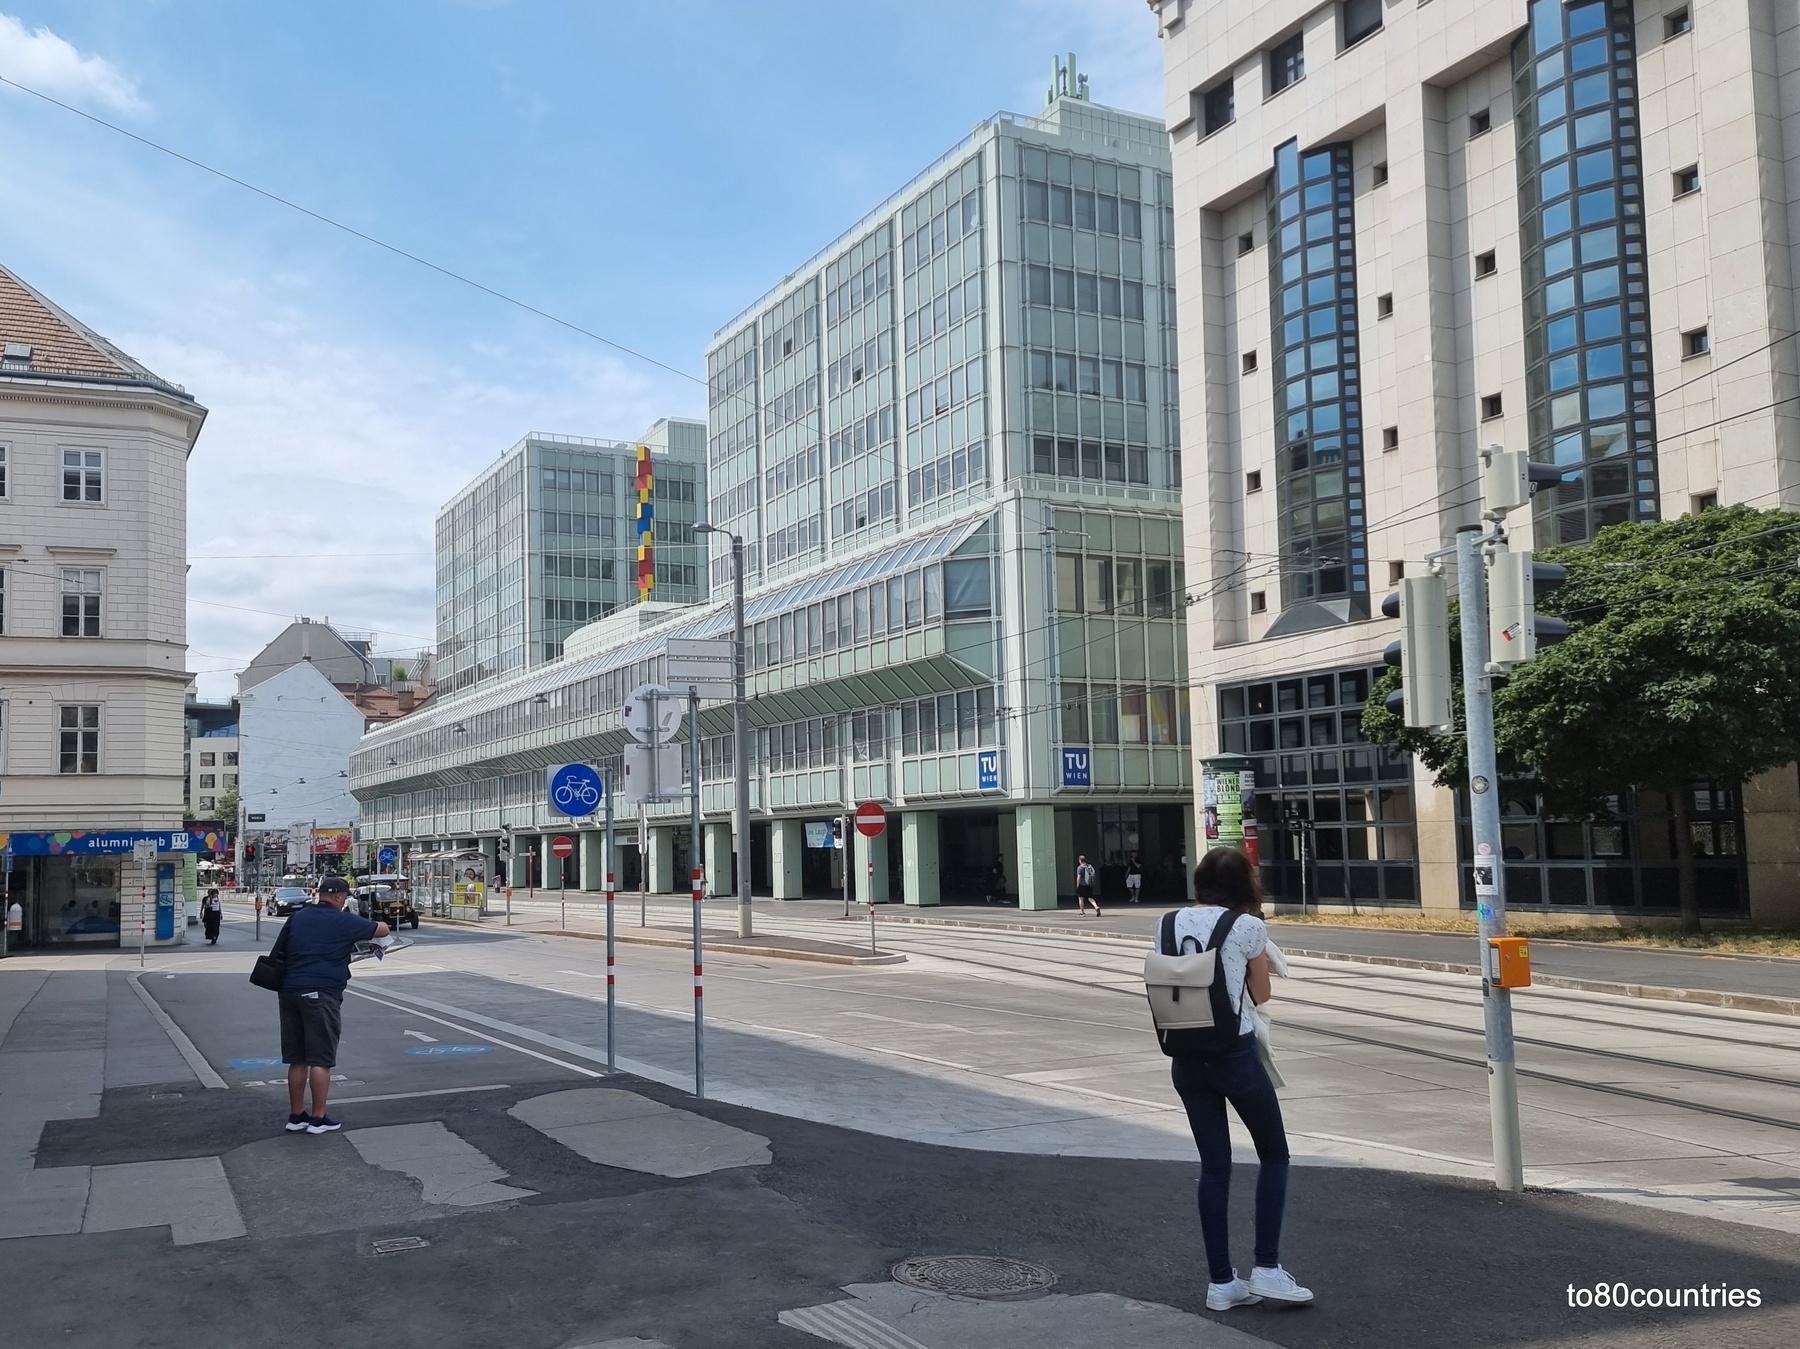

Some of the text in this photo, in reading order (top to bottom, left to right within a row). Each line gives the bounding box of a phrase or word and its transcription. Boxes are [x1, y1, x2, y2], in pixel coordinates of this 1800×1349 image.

[981, 755, 997, 773] TU
[1065, 754, 1087, 770] TU
[982, 775, 997, 783] WIEN
[1065, 772, 1088, 780] WIEN
[1216, 777, 1240, 785] WIENER
[88, 837, 133, 848] alumni
[173, 834, 187, 843] TU
